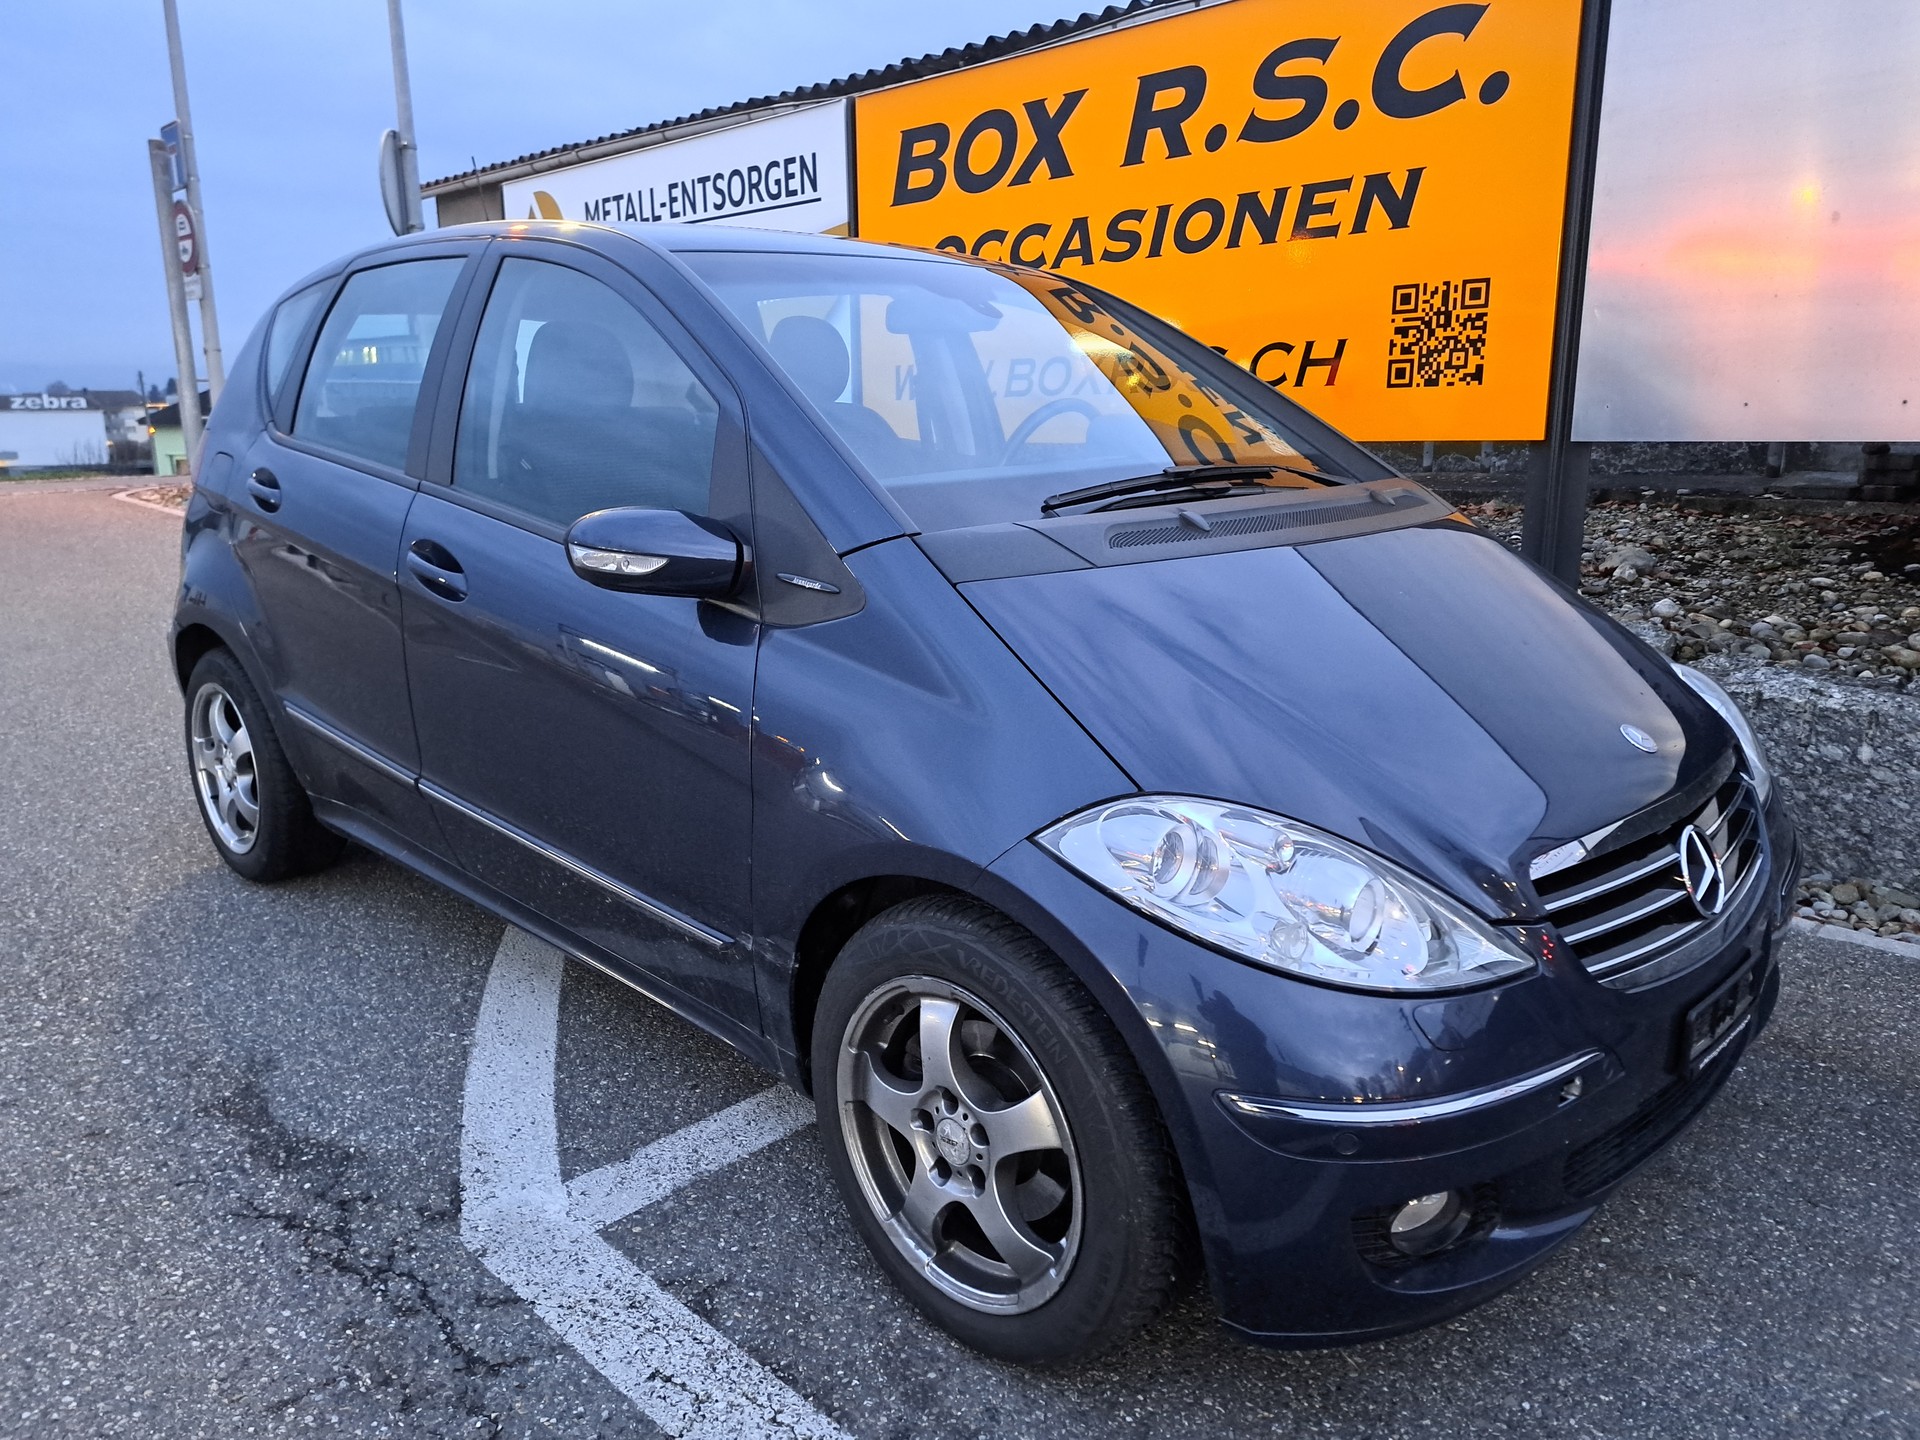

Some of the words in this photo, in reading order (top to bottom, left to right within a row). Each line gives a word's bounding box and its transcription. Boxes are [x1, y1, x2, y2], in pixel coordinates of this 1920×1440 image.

[890, 88, 1089, 207] BOX
[1120, 3, 1511, 168] R.S.C.
[584, 151, 819, 222] METALL-ENTSORGEN
[10, 393, 88, 410] zebra
[957, 948, 1068, 1065] VREDESTEIN
